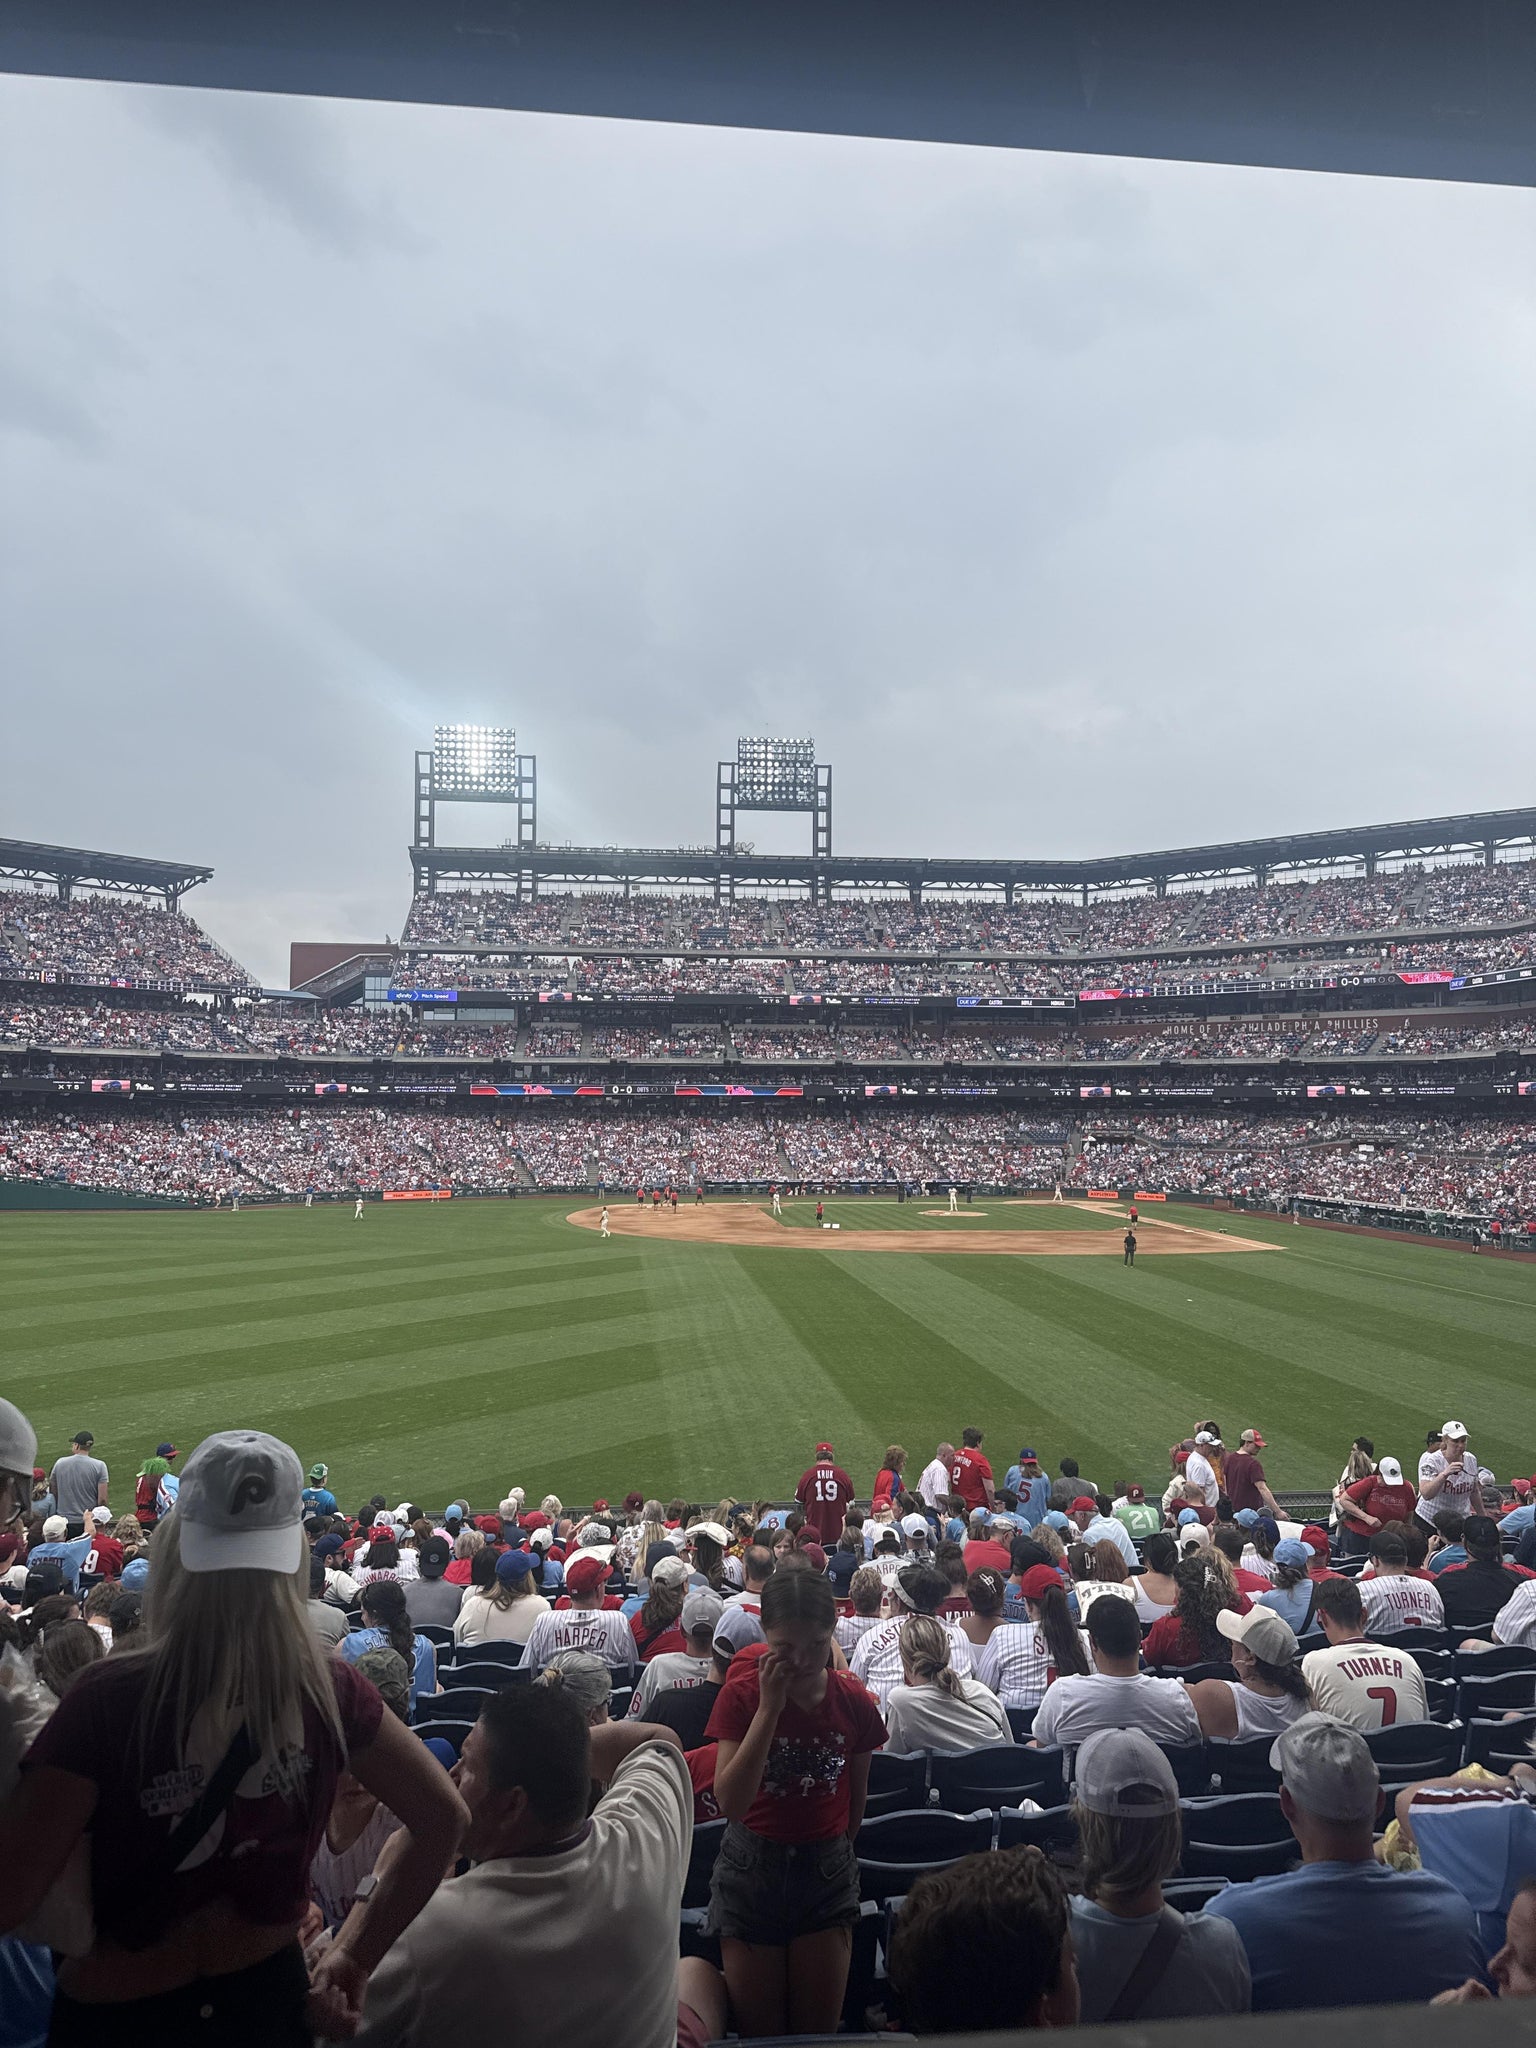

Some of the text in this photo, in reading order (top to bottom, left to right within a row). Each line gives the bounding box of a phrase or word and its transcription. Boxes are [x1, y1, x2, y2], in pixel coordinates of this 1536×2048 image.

[1167, 1024, 1194, 1035] HOME
[1200, 1024, 1211, 1034] OF
[816, 1469, 834, 1479] KRUK
[952, 1466, 961, 1485] 2
[815, 1480, 838, 1501] 19
[1016, 1481, 1033, 1503] 5
[768, 1517, 780, 1529] 8
[1128, 1510, 1154, 1530] 21
[1384, 1592, 1431, 1611] TURNER
[554, 1628, 608, 1650] HARPER
[1337, 1657, 1403, 1681] TURNER
[631, 1691, 643, 1714] 6
[1367, 1686, 1397, 1727] 7
[800, 1777, 815, 1797] P
